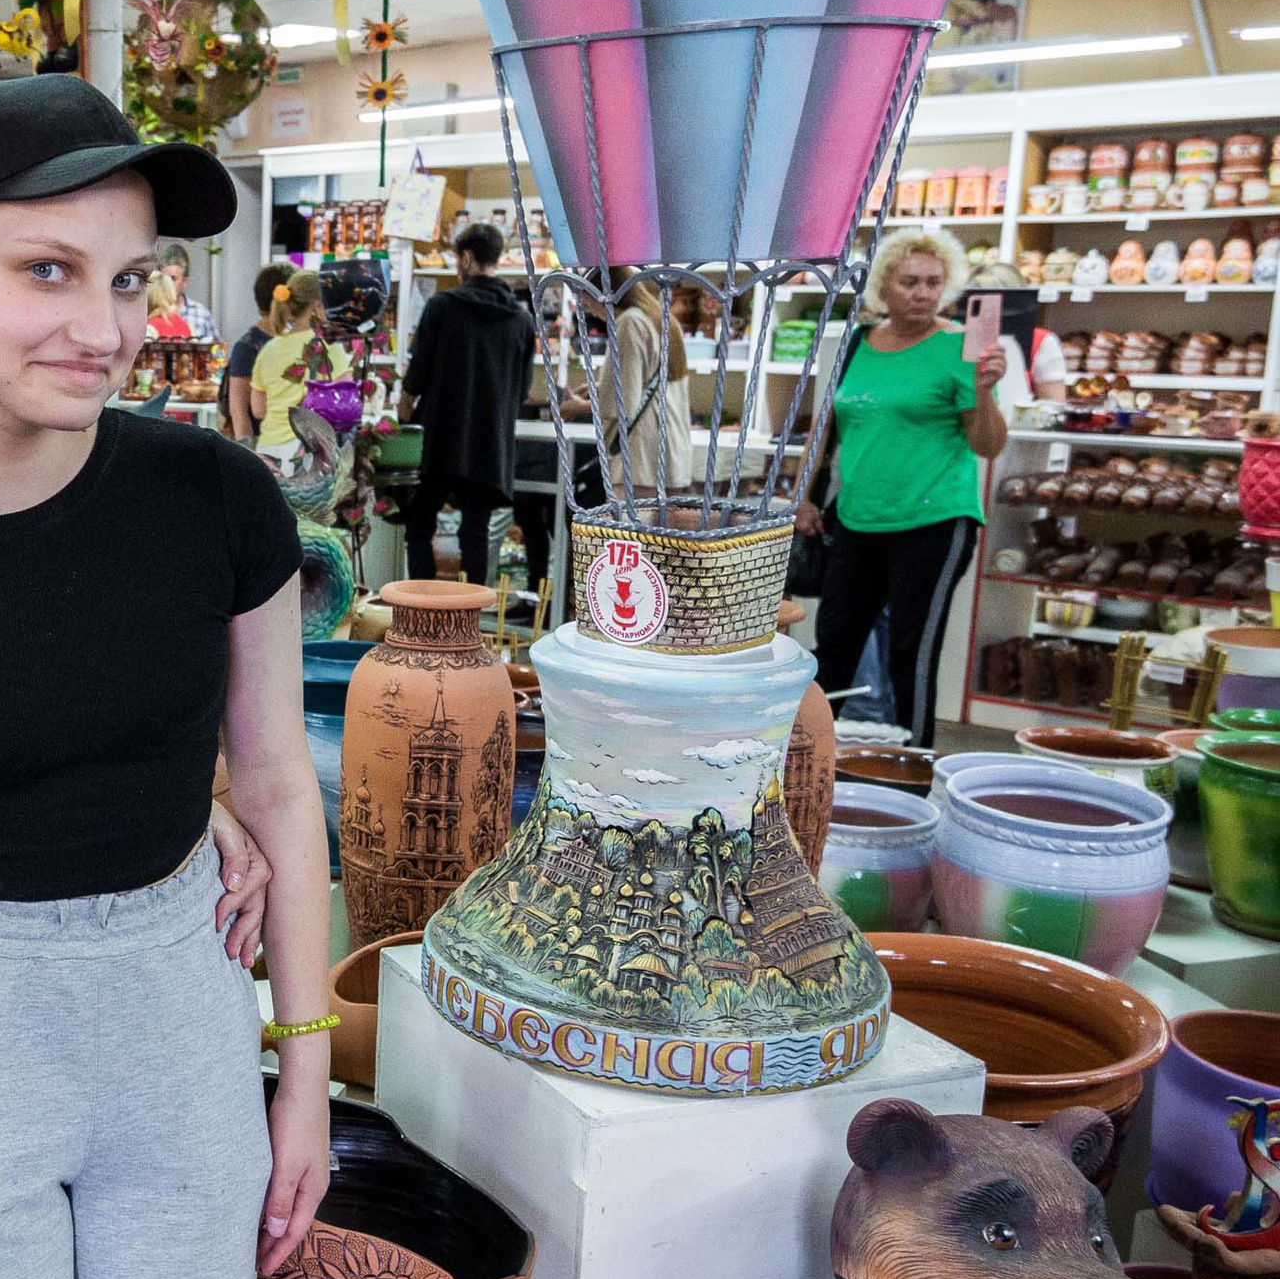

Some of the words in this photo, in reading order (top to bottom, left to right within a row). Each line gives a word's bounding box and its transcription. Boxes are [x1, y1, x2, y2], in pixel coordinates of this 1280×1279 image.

[606, 542, 639, 569] 175
[589, 562, 605, 622] КУНГУРСКОМУ
[604, 620, 655, 639] ГОНЧАРНОМУ
[643, 568, 663, 620] ПРОМЫСЛУ
[426, 955, 765, 1087] НЕБЕСНАЯ
